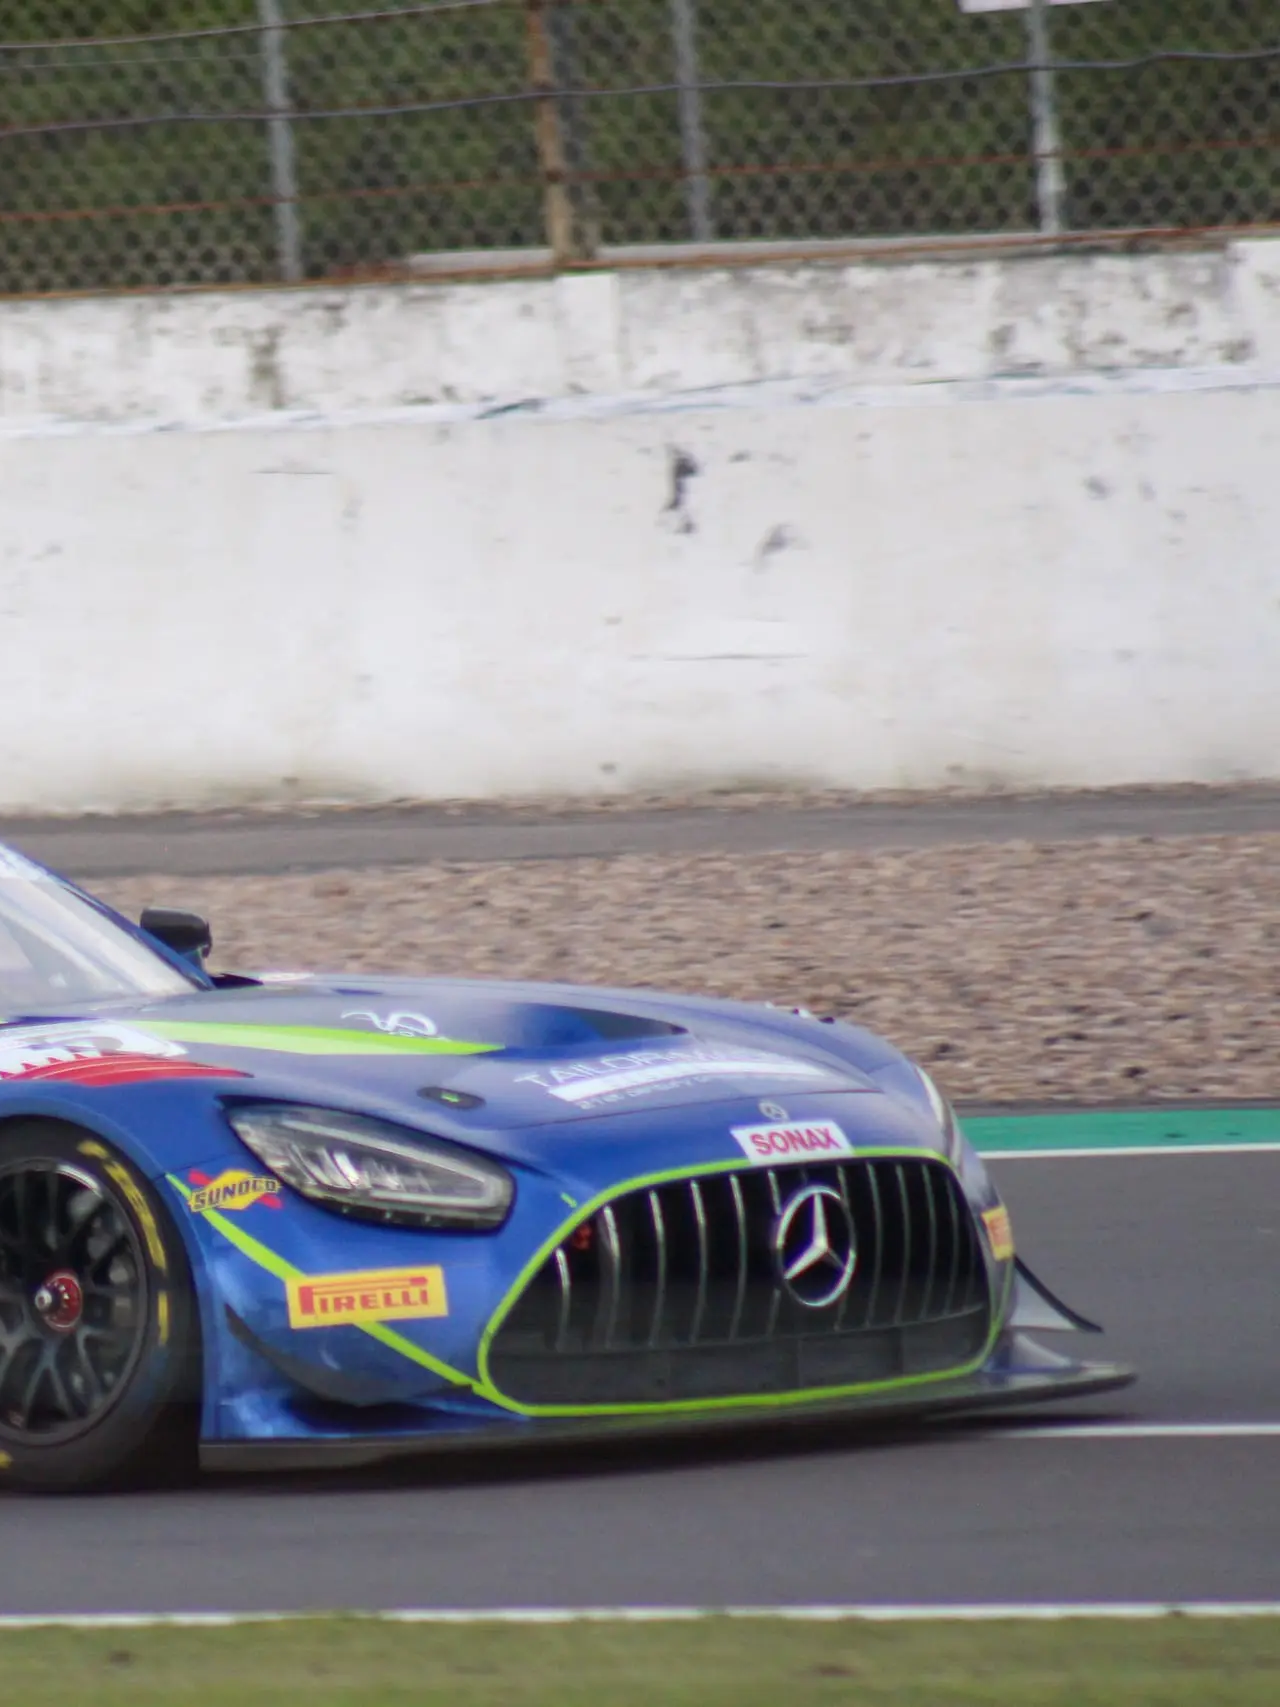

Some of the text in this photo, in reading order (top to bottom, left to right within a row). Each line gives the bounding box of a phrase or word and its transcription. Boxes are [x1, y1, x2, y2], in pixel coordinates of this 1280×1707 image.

[748, 1127, 842, 1156] SONAX
[193, 1178, 278, 1210] SUNOCO
[298, 1276, 429, 1315] PIRELLI
